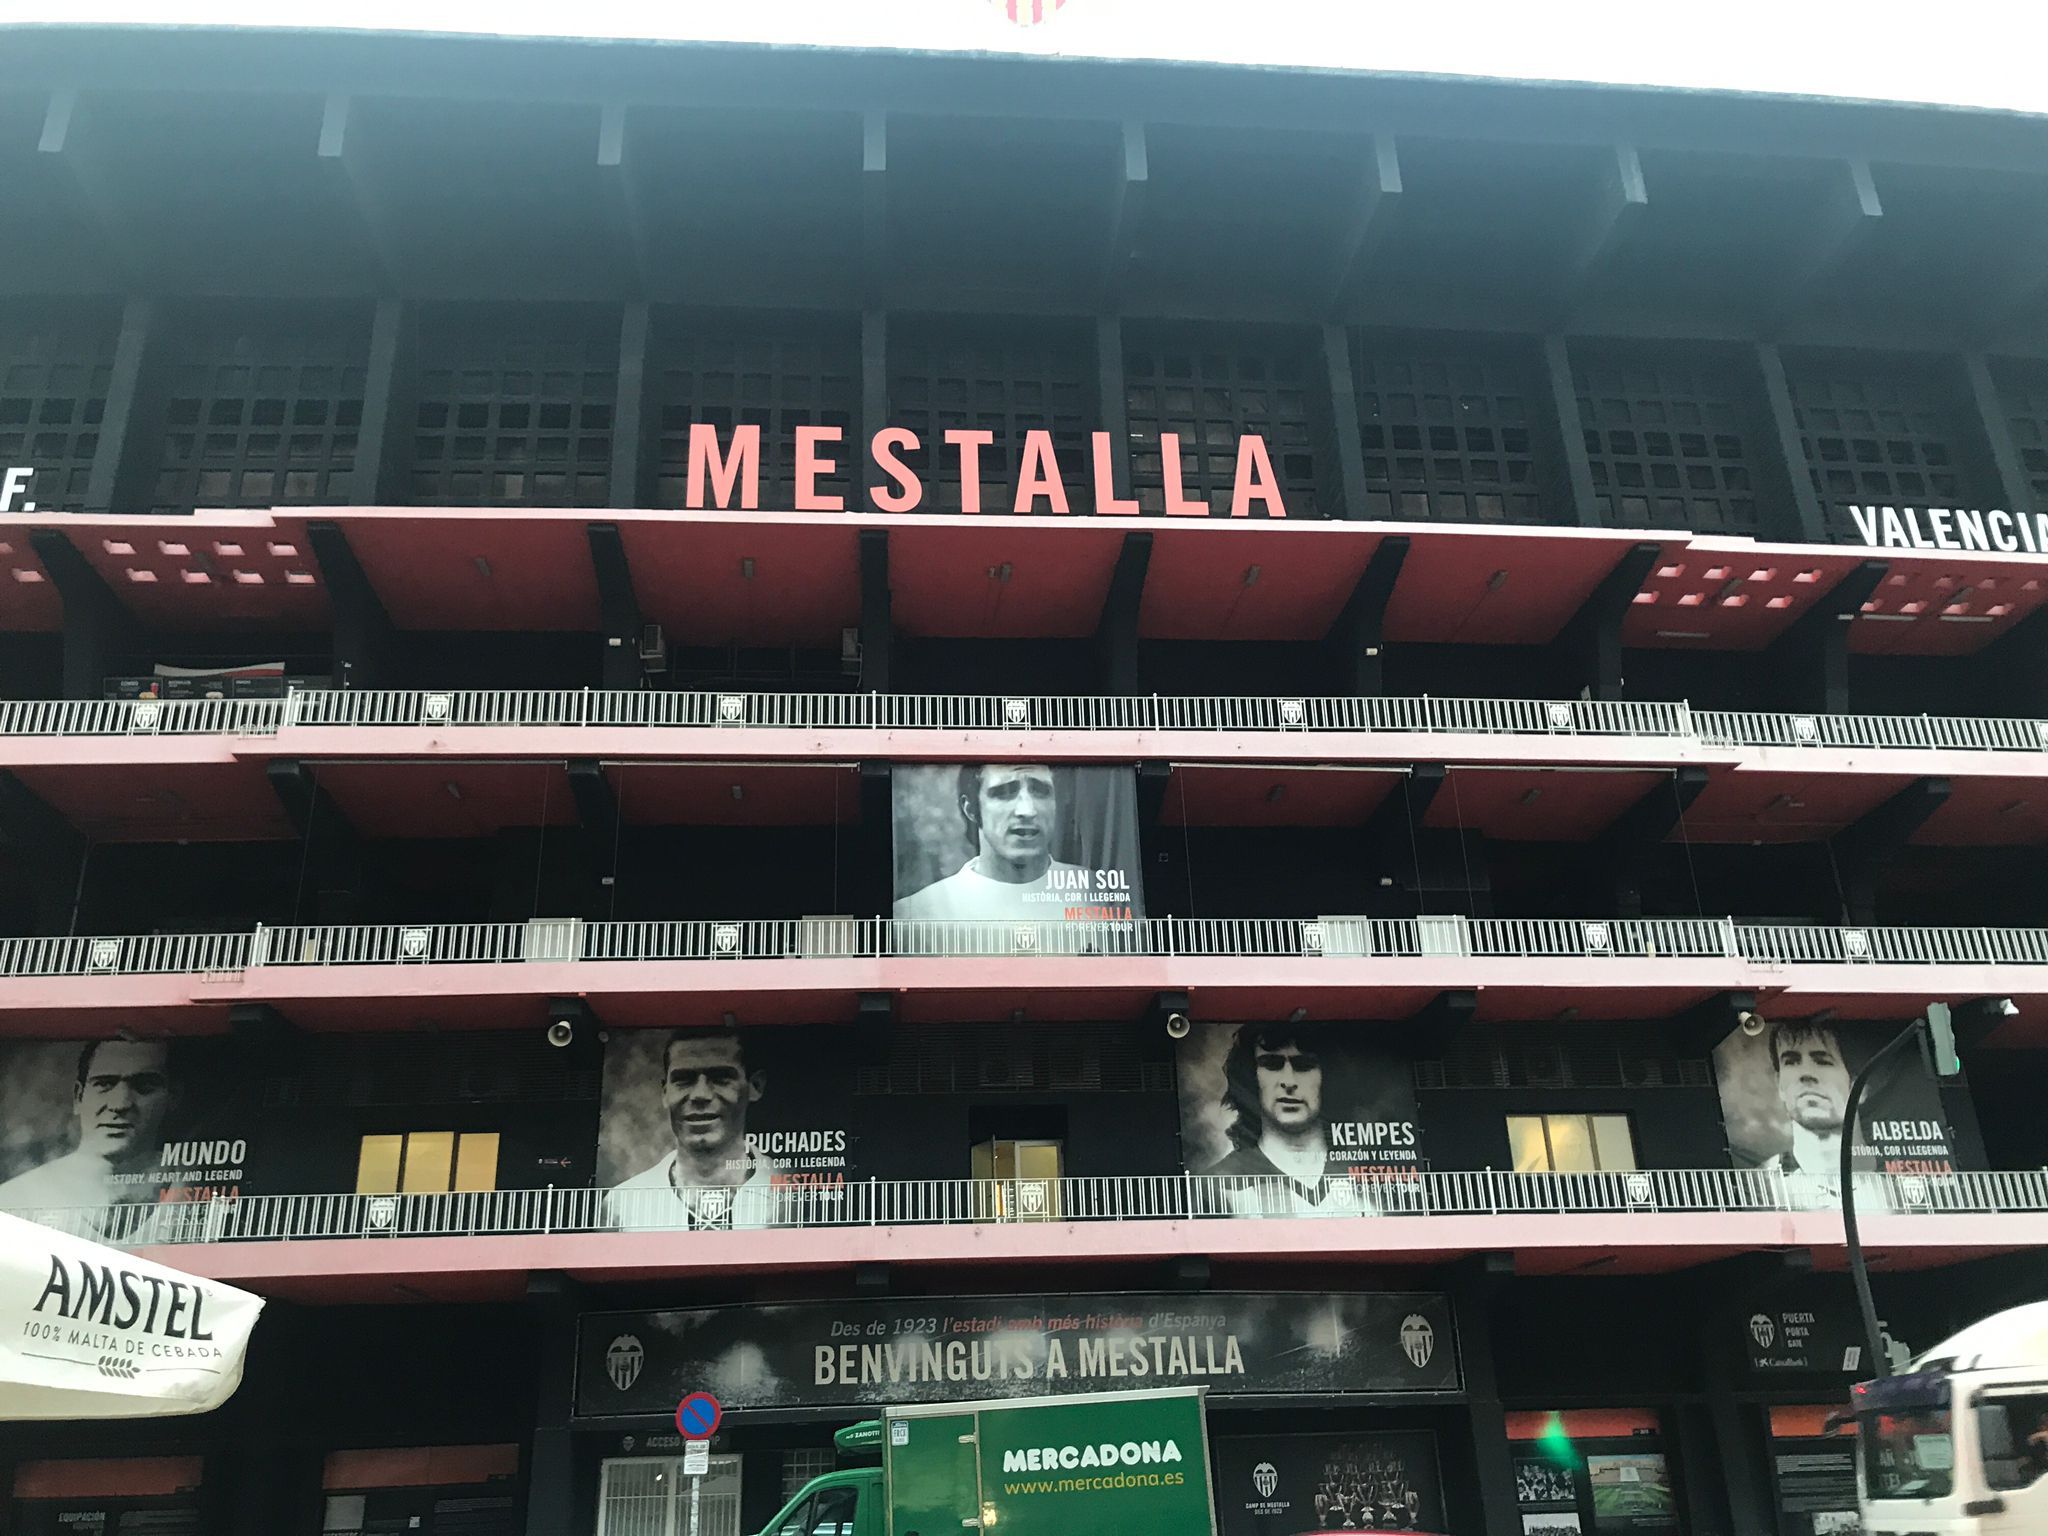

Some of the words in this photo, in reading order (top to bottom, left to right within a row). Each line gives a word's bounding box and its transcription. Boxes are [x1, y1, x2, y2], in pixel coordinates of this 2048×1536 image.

[685, 423, 1287, 517] MESTALLA
[0, 467, 36, 512] F.
[1045, 869, 1090, 890] JUAN
[1095, 869, 1130, 890] SOL
[1064, 892, 1082, 902] COR
[1084, 892, 1088, 902] I
[1089, 892, 1131, 902] LLEGENDA
[1064, 906, 1133, 921] MESTALLA
[1330, 1121, 1415, 1146] KEMPES
[1872, 1120, 1944, 1141] ALBELDA
[160, 1139, 247, 1167] MUNDO
[1329, 1148, 1370, 1161] CORAZÓN
[1371, 1150, 1377, 1161] Y
[1379, 1150, 1417, 1161] LEYENDA
[1884, 1145, 1902, 1156] COR
[1903, 1145, 1907, 1156] I
[1908, 1145, 1949, 1156] LLEGENDA
[773, 1158, 792, 1168] COR
[794, 1158, 798, 1168] I
[800, 1156, 846, 1168] LLEGENDA
[1884, 1160, 1953, 1175] MESTALLA
[148, 1170, 181, 1183] HEART
[182, 1170, 202, 1182] AND
[205, 1169, 243, 1182] LEGEND
[770, 1172, 845, 1192] MESTALLA
[1347, 1165, 1420, 1183] MESTALLA
[32, 1254, 213, 1341] AMSTEL
[830, 1320, 861, 1337] Des
[866, 1319, 887, 1337] de
[893, 1317, 938, 1335] 1923
[942, 1316, 1003, 1333] l'estadi
[1047, 1313, 1081, 1330] més
[1084, 1312, 1144, 1329] història
[1149, 1311, 1227, 1331] d'Espanya
[1782, 1312, 1816, 1324] PUERTA
[23, 1321, 62, 1342] 100%
[68, 1329, 118, 1351] MALTA
[125, 1339, 145, 1356] DE
[151, 1343, 223, 1359] CEBADA
[814, 1339, 1034, 1386] BENVINGUTS
[1046, 1337, 1068, 1378] A
[1078, 1334, 1246, 1378] MESTALLA
[645, 1436, 681, 1448] ACCESO
[854, 1429, 881, 1438] ZANOTTI
[1003, 1439, 1183, 1473] MERCADONA
[1004, 1472, 1185, 1495] www.mercadona.es
